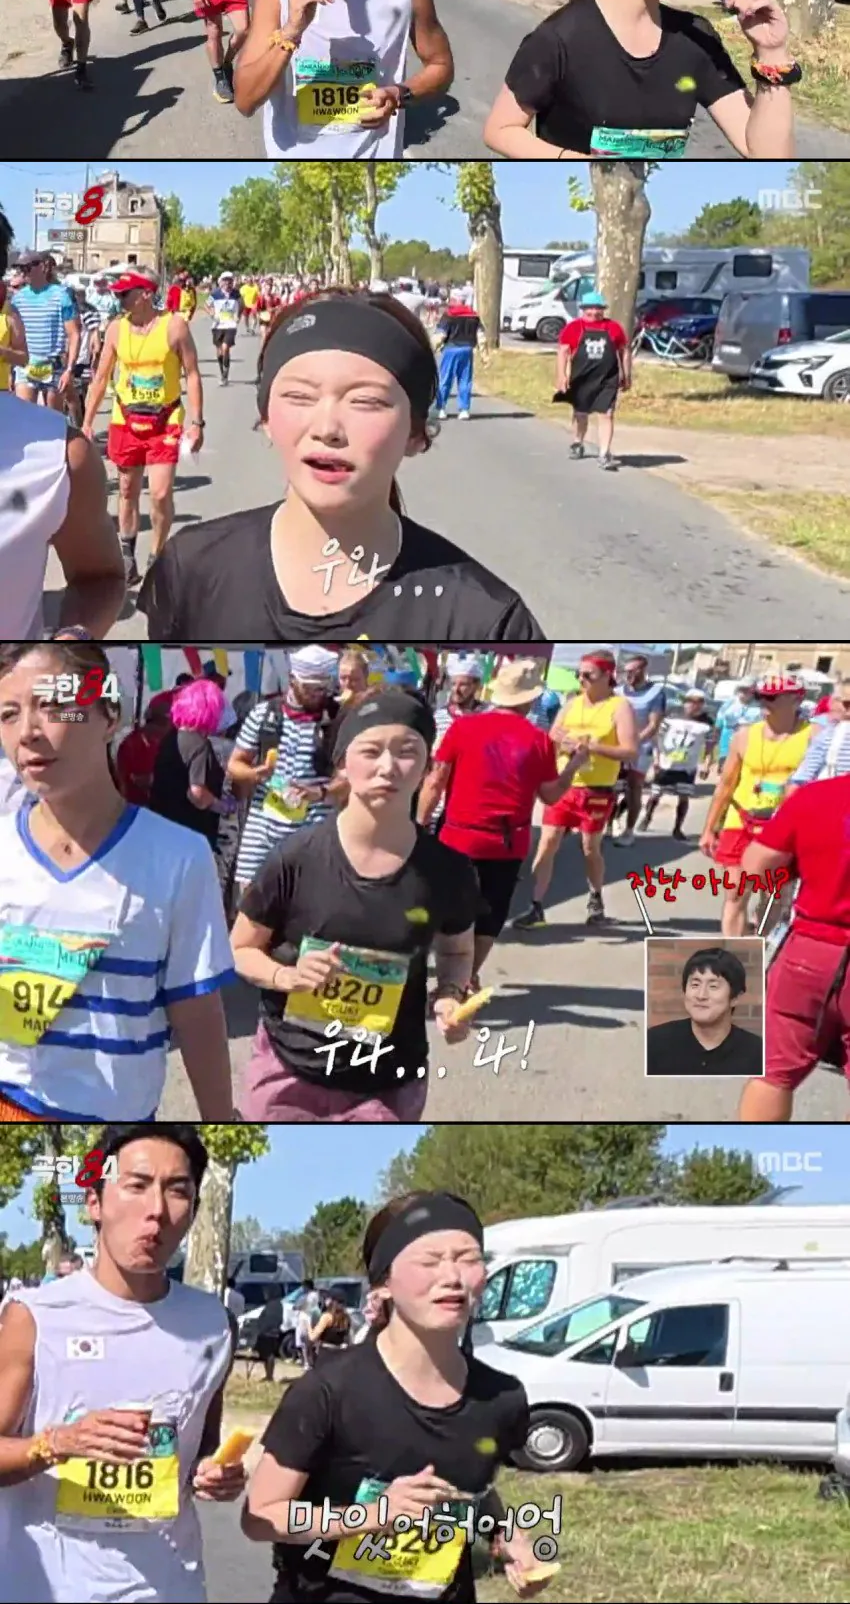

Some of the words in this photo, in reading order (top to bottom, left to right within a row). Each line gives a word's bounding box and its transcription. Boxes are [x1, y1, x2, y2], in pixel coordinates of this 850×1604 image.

[312, 86, 360, 107] 1816
[85, 1460, 154, 1490] 1816
[83, 1493, 152, 1504] HWAWOON
